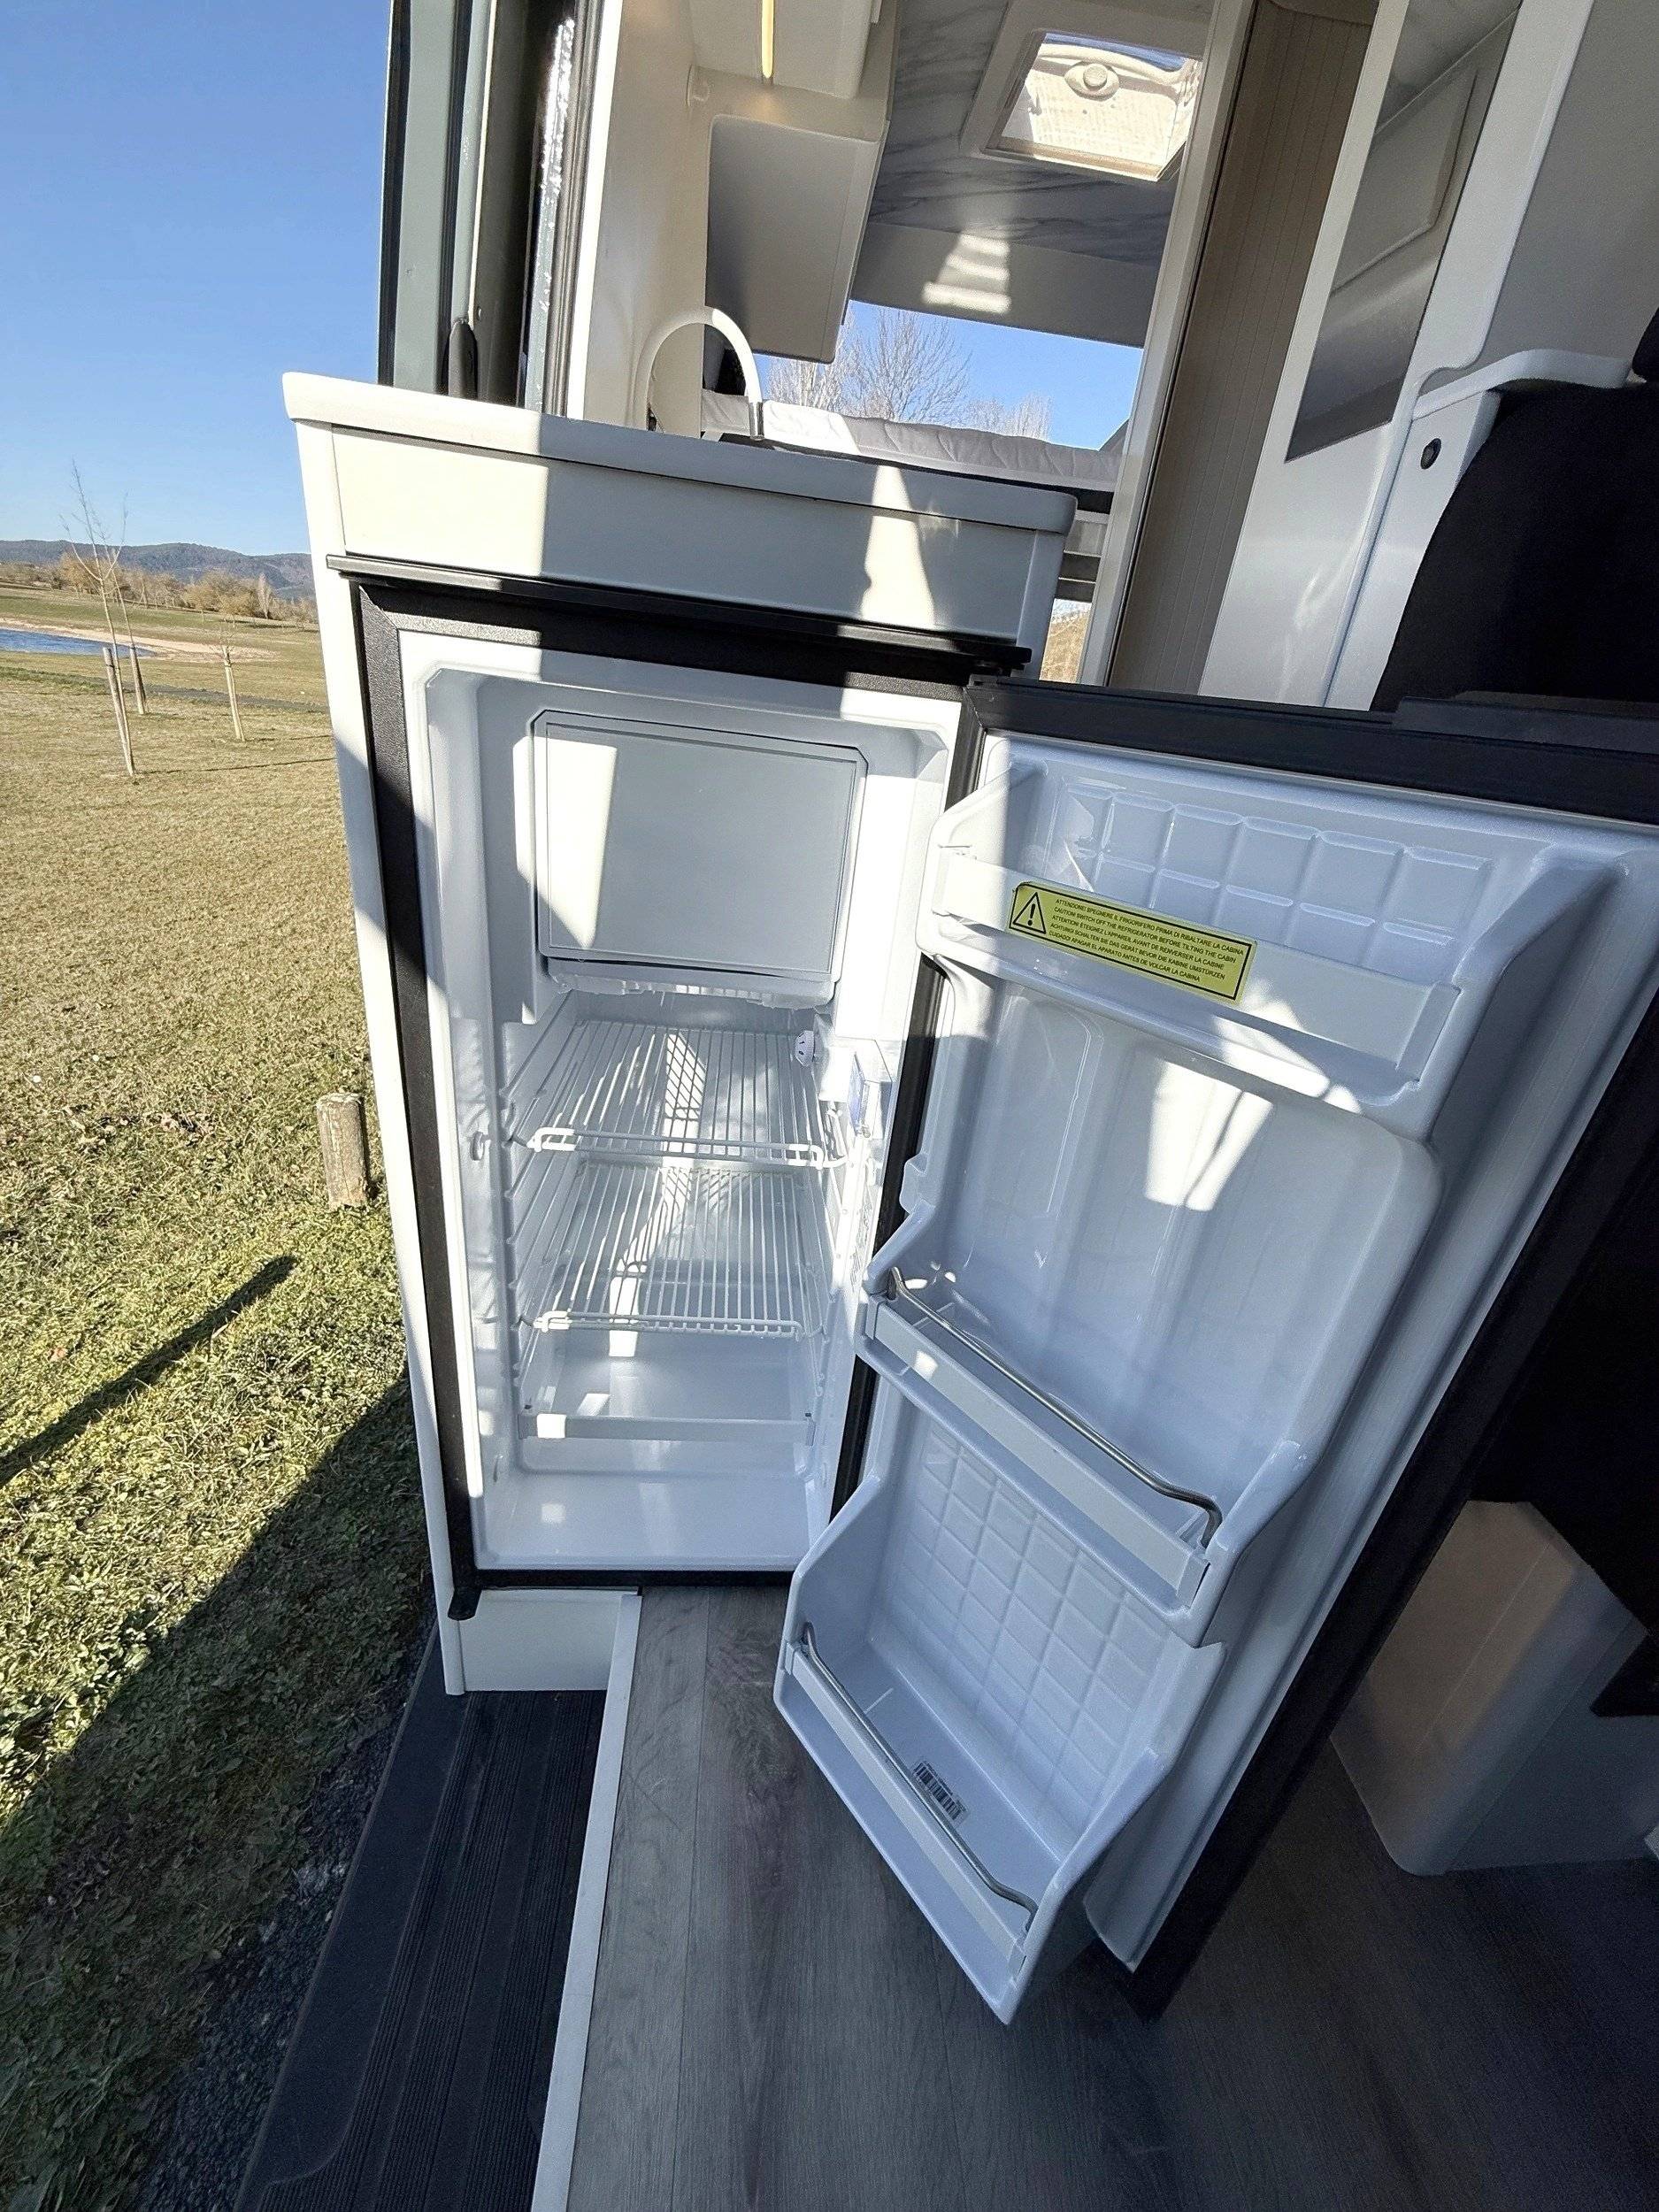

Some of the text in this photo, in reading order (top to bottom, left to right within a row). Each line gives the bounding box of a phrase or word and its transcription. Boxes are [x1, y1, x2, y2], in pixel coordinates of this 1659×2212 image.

[1133, 938, 1151, 948] AVANT
[1202, 958, 1224, 970] CABINE
[1155, 926, 1172, 935] PRIMA
[1221, 944, 1244, 956] CABINA
[1121, 952, 1140, 963] ANTES
[1148, 960, 1171, 972] VOLCAR
[1179, 970, 1201, 981] CABINA
[1217, 953, 1236, 963] CABIN
